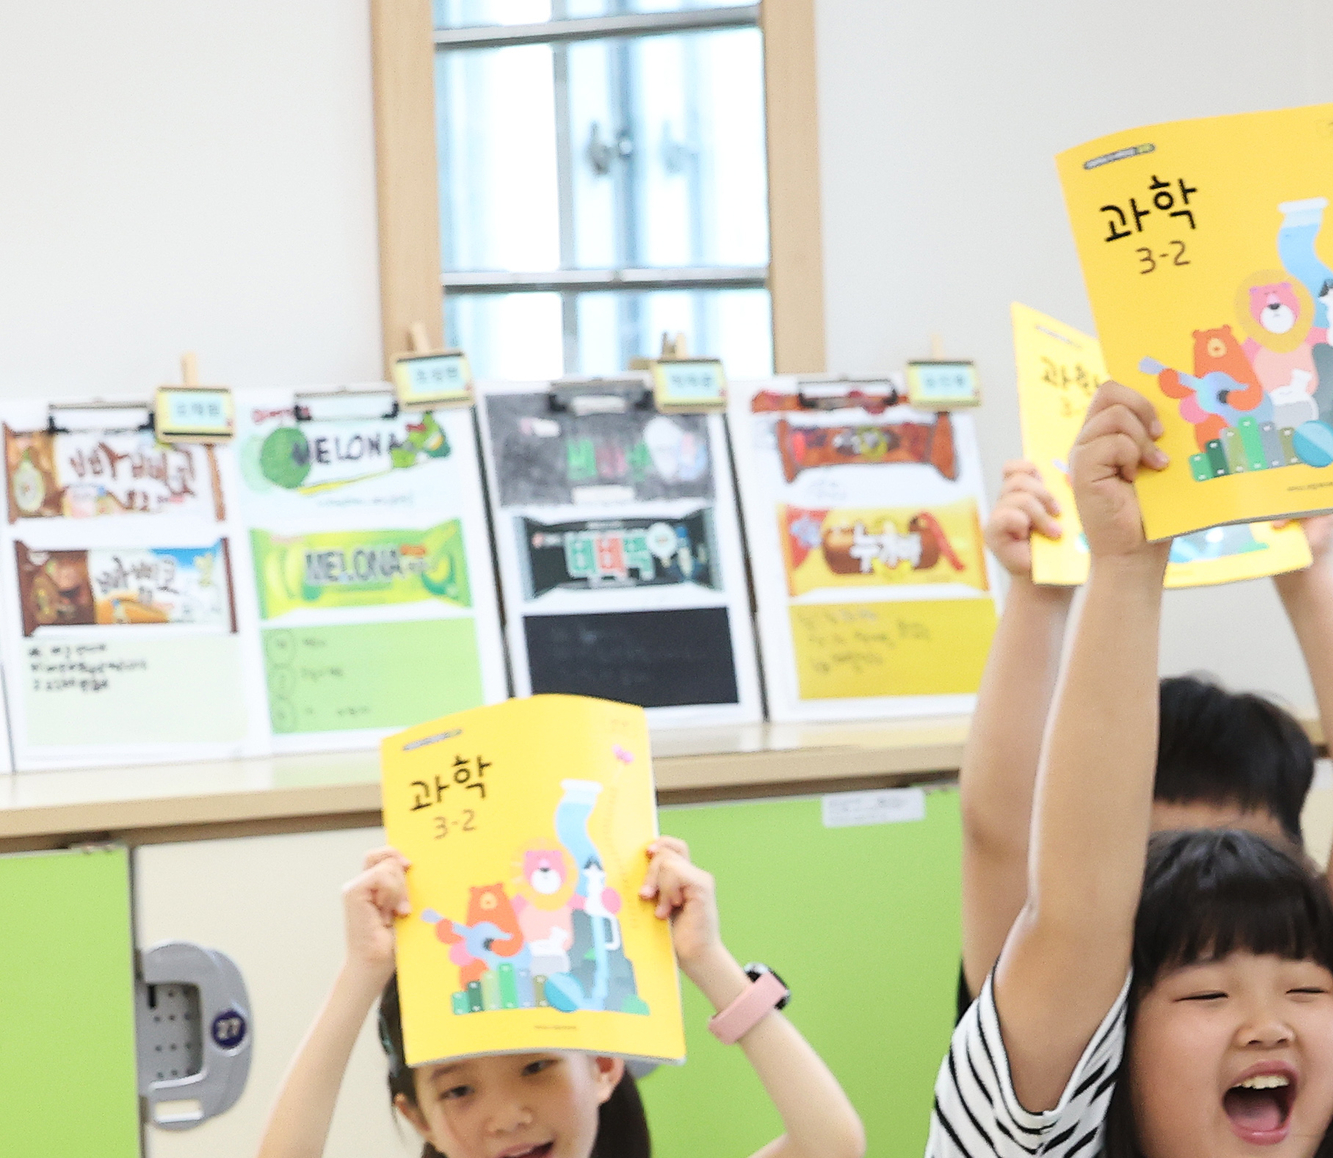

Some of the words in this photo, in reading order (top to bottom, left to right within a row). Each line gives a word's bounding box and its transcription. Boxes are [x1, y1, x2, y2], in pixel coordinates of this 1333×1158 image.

[1099, 174, 1198, 242] 과학
[1135, 240, 1192, 275] 3-2
[409, 754, 494, 812] 과학
[432, 808, 477, 840] 3-2
